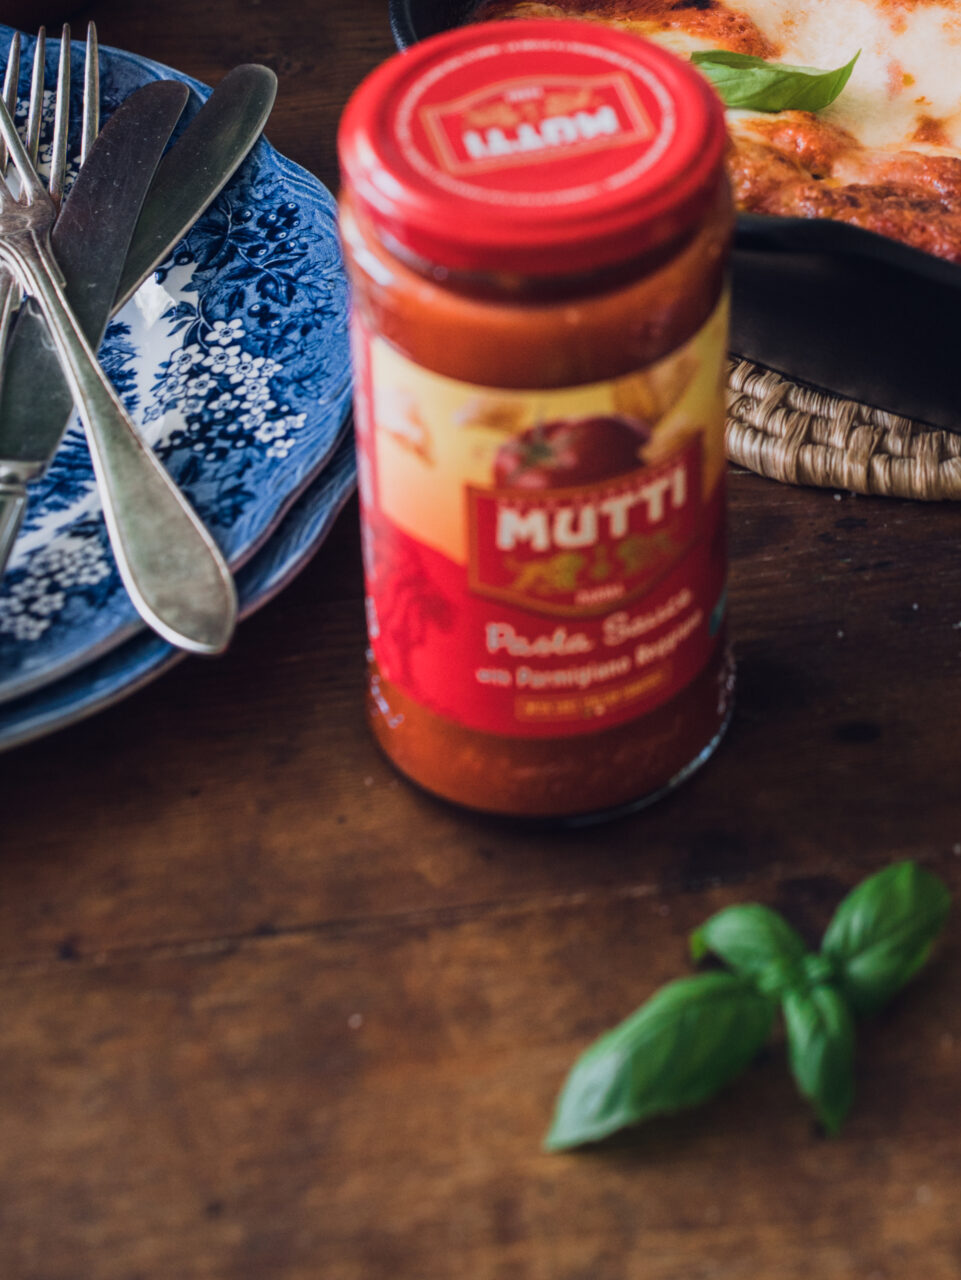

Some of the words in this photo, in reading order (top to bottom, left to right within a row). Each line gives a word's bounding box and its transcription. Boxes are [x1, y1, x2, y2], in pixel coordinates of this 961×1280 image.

[463, 105, 618, 159] MUTTI
[497, 468, 687, 551] MUTTI
[486, 622, 593, 658] Pasta
